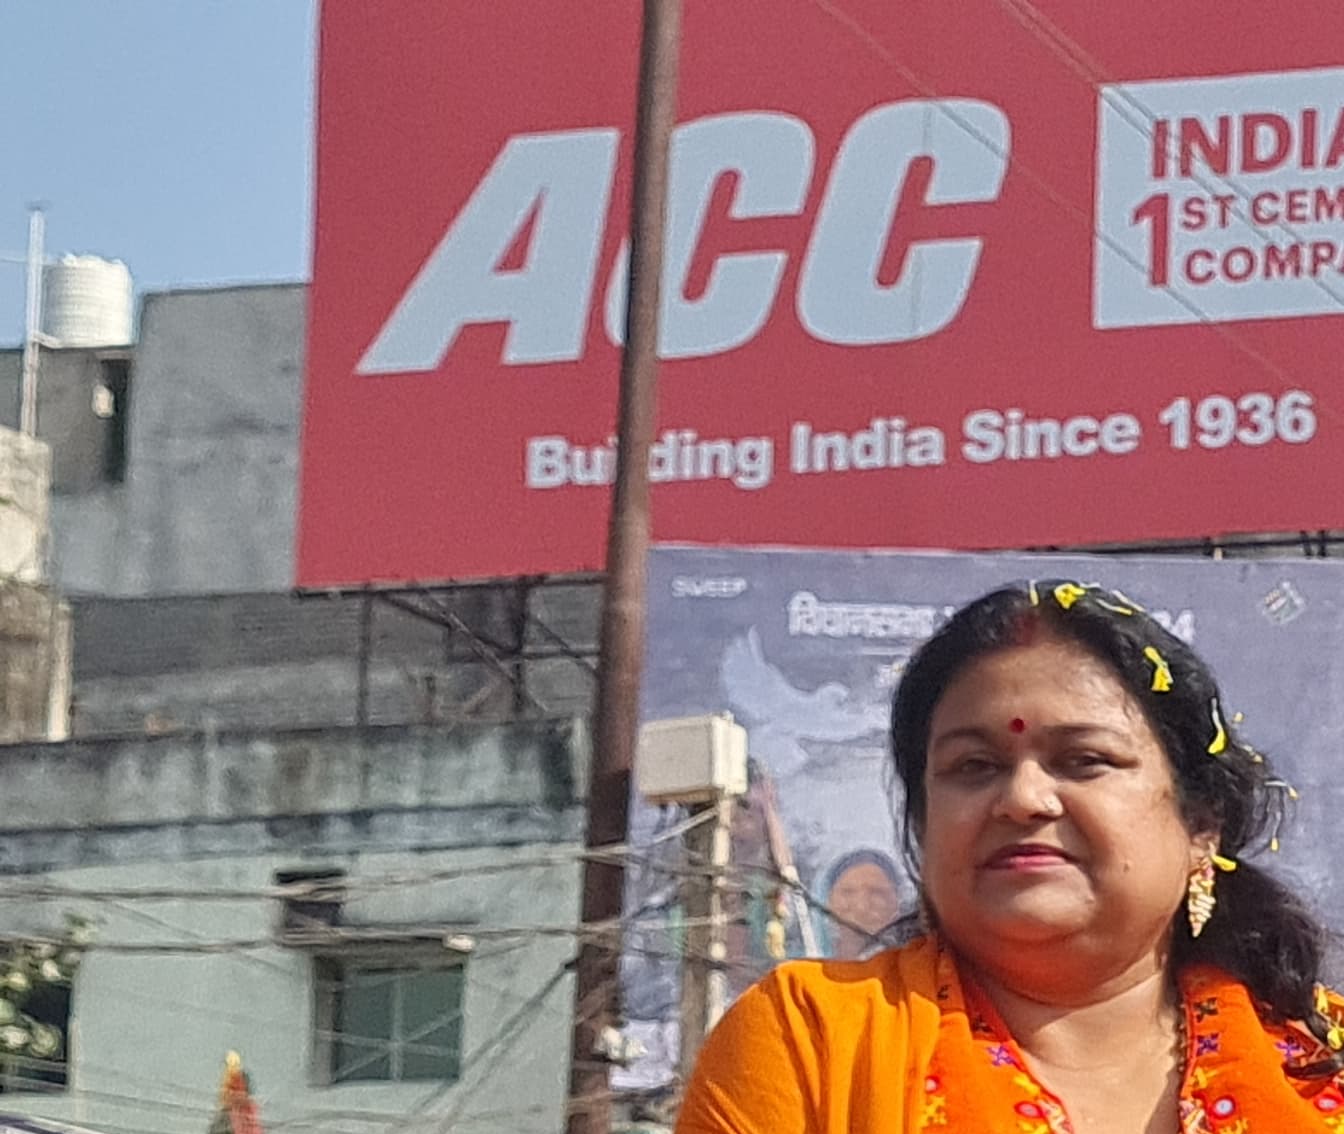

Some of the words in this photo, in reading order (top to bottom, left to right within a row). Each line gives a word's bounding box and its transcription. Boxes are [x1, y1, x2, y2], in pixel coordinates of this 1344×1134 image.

[353, 96, 1012, 375] ACC
[526, 429, 775, 490] Buiding
[790, 416, 946, 474] India
[962, 407, 1141, 463] Since
[1158, 390, 1318, 449] 1936
